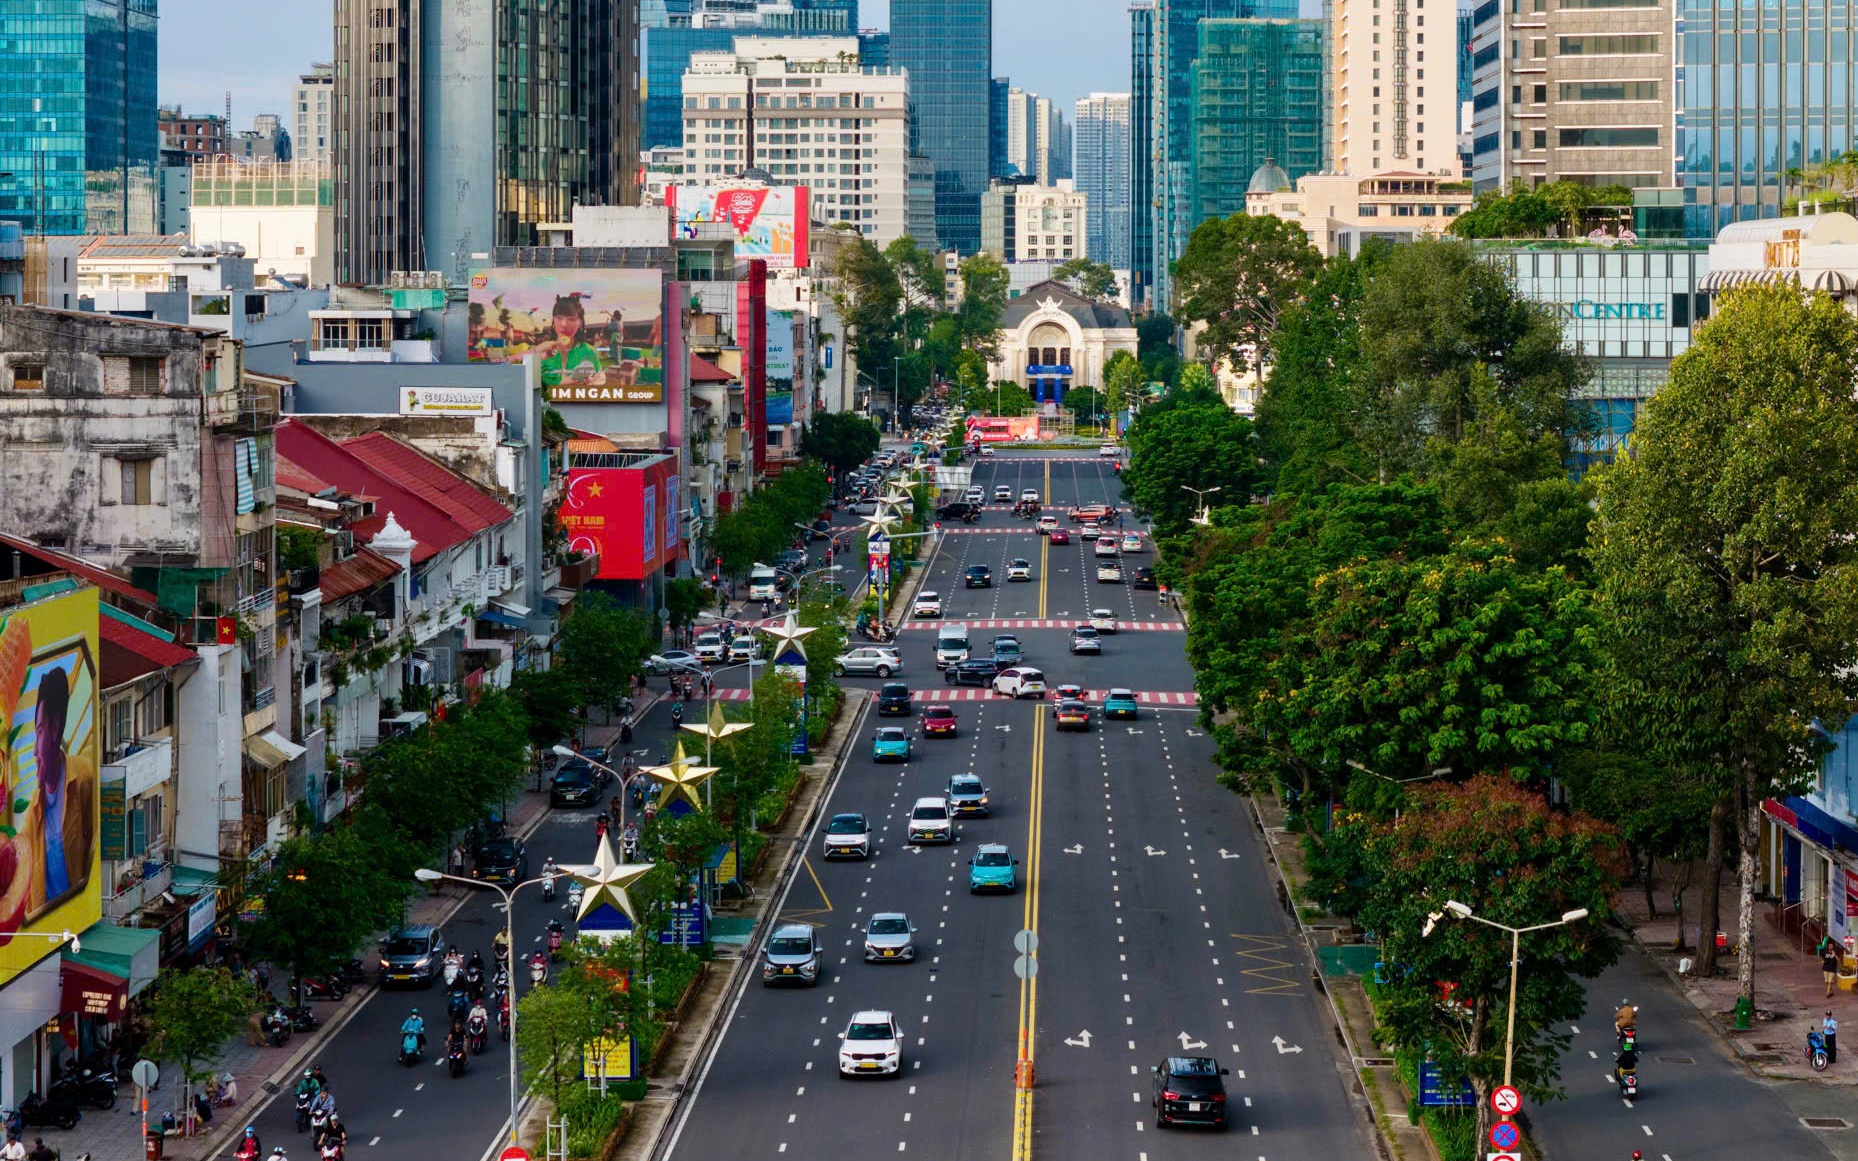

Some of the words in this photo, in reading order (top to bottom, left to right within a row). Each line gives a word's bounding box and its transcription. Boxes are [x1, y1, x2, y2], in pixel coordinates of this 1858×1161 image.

[422, 392, 485, 404] GUJARAT
[575, 388, 624, 399] NGAN
[627, 391, 654, 399] GROUP
[583, 515, 604, 525] NAM
